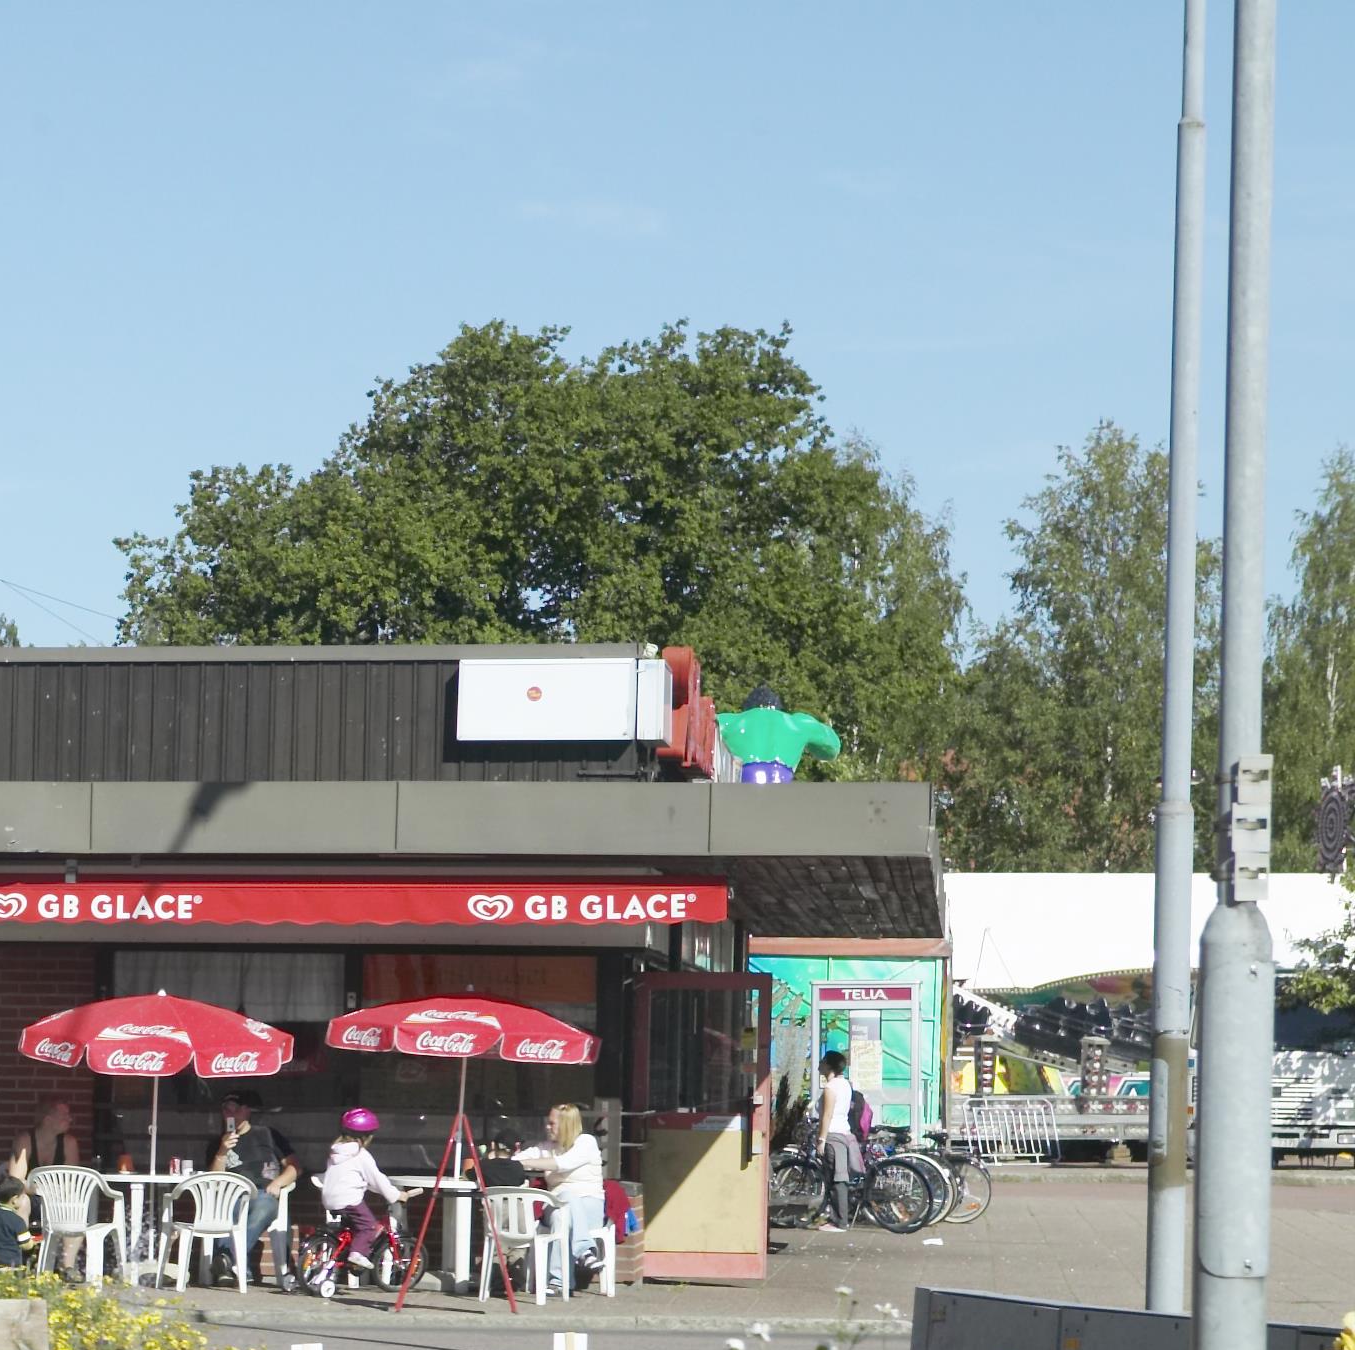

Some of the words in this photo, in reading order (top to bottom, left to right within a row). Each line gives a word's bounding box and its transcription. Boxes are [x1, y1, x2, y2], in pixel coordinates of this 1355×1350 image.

[37, 893, 80, 919] GB
[524, 895, 568, 920] GB
[841, 988, 889, 1001] TELIA
